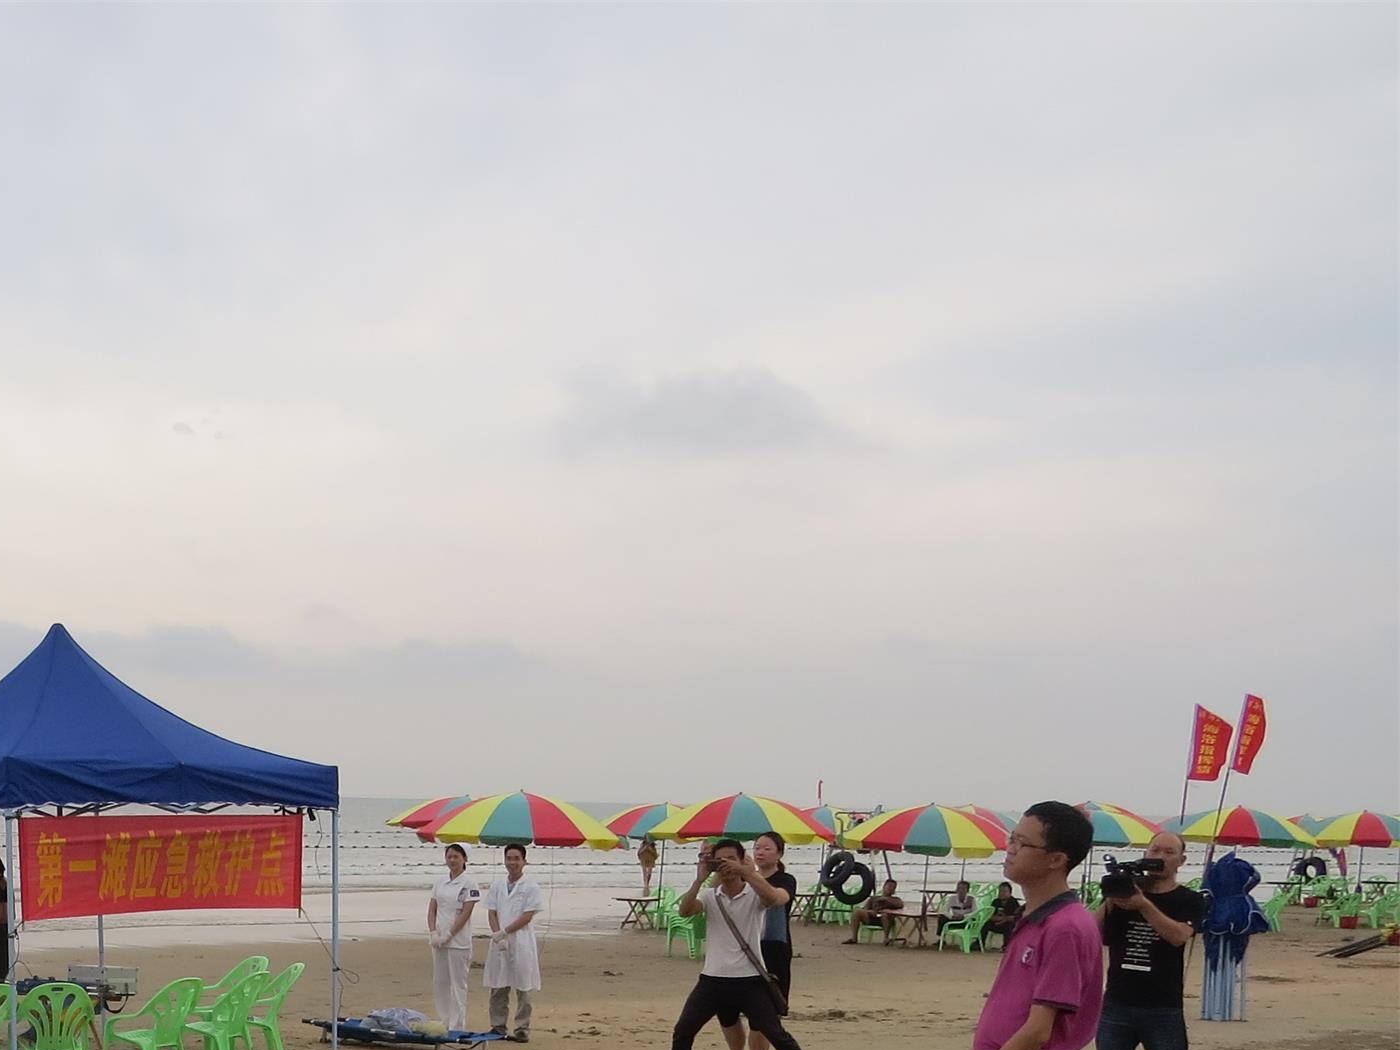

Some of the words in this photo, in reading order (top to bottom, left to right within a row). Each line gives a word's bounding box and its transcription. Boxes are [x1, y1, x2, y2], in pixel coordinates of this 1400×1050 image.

[36, 829, 286, 907] 第一滩应急救护点
